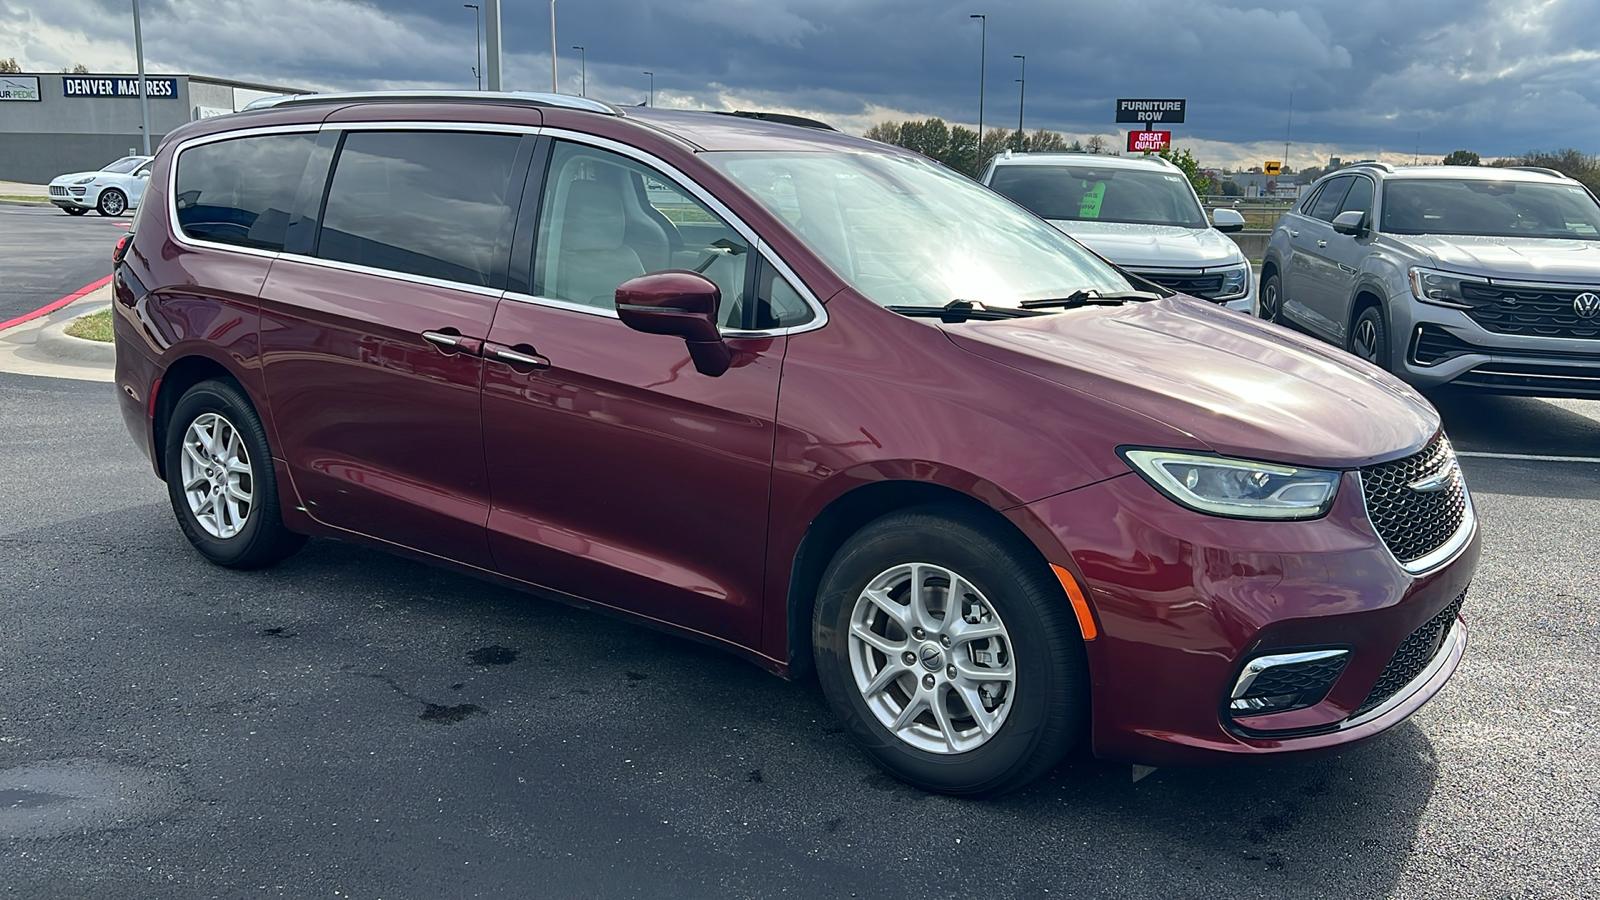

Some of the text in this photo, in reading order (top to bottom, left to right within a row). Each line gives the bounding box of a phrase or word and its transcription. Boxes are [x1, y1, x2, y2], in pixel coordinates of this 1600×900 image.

[66, 79, 172, 96] DENVER MATRESS
[1121, 101, 1181, 111] FURNITURE
[1137, 111, 1163, 121] ROW
[1138, 132, 1163, 142] GREAT
